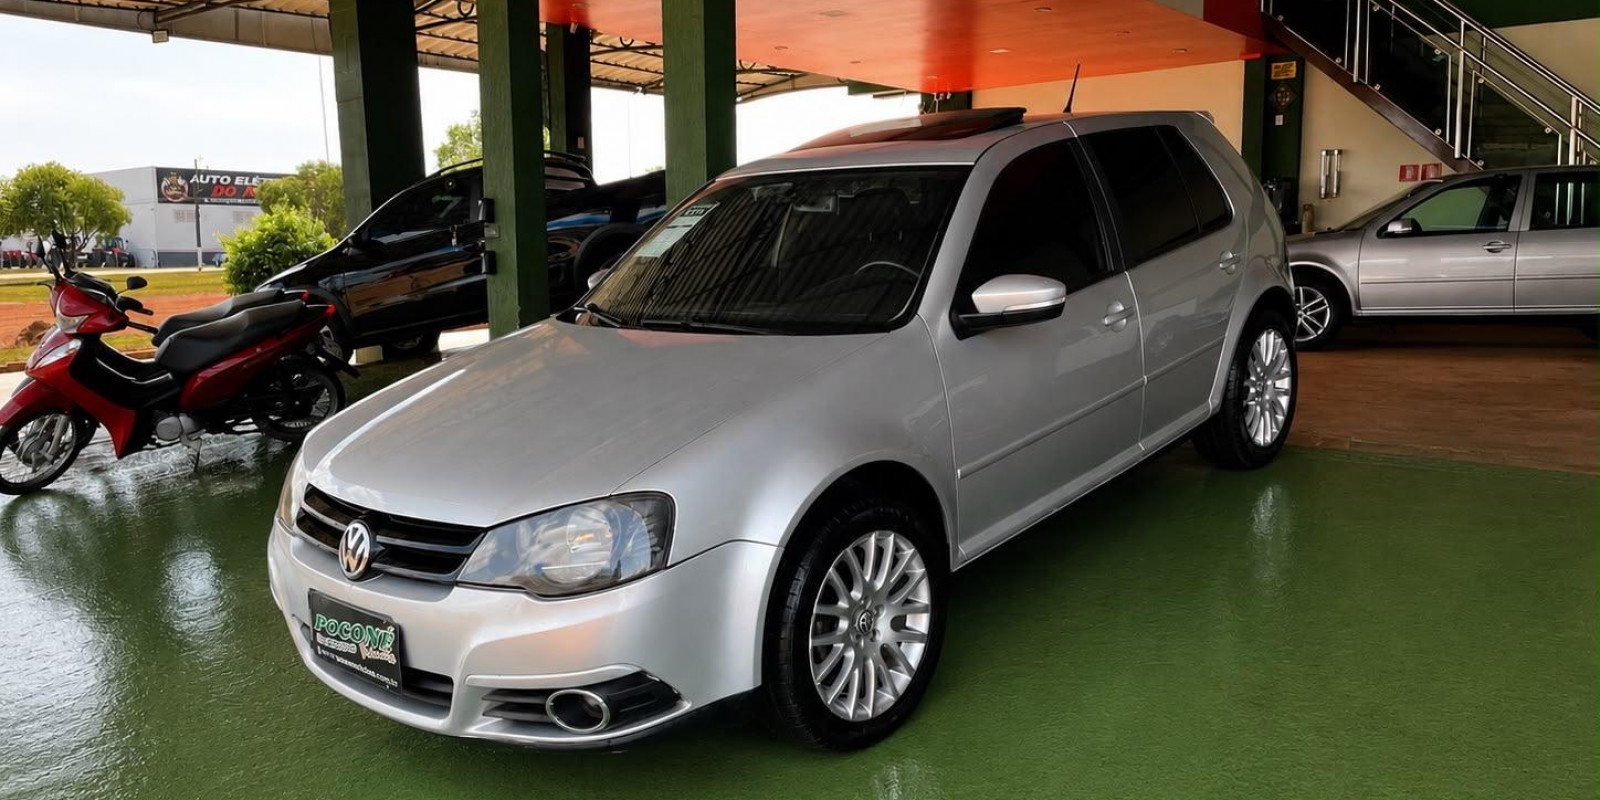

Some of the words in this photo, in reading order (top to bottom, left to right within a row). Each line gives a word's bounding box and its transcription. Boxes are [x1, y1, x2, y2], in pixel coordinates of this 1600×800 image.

[190, 174, 231, 185] AUTO
[211, 184, 237, 198] DO
[314, 613, 395, 653] POCONÉ
